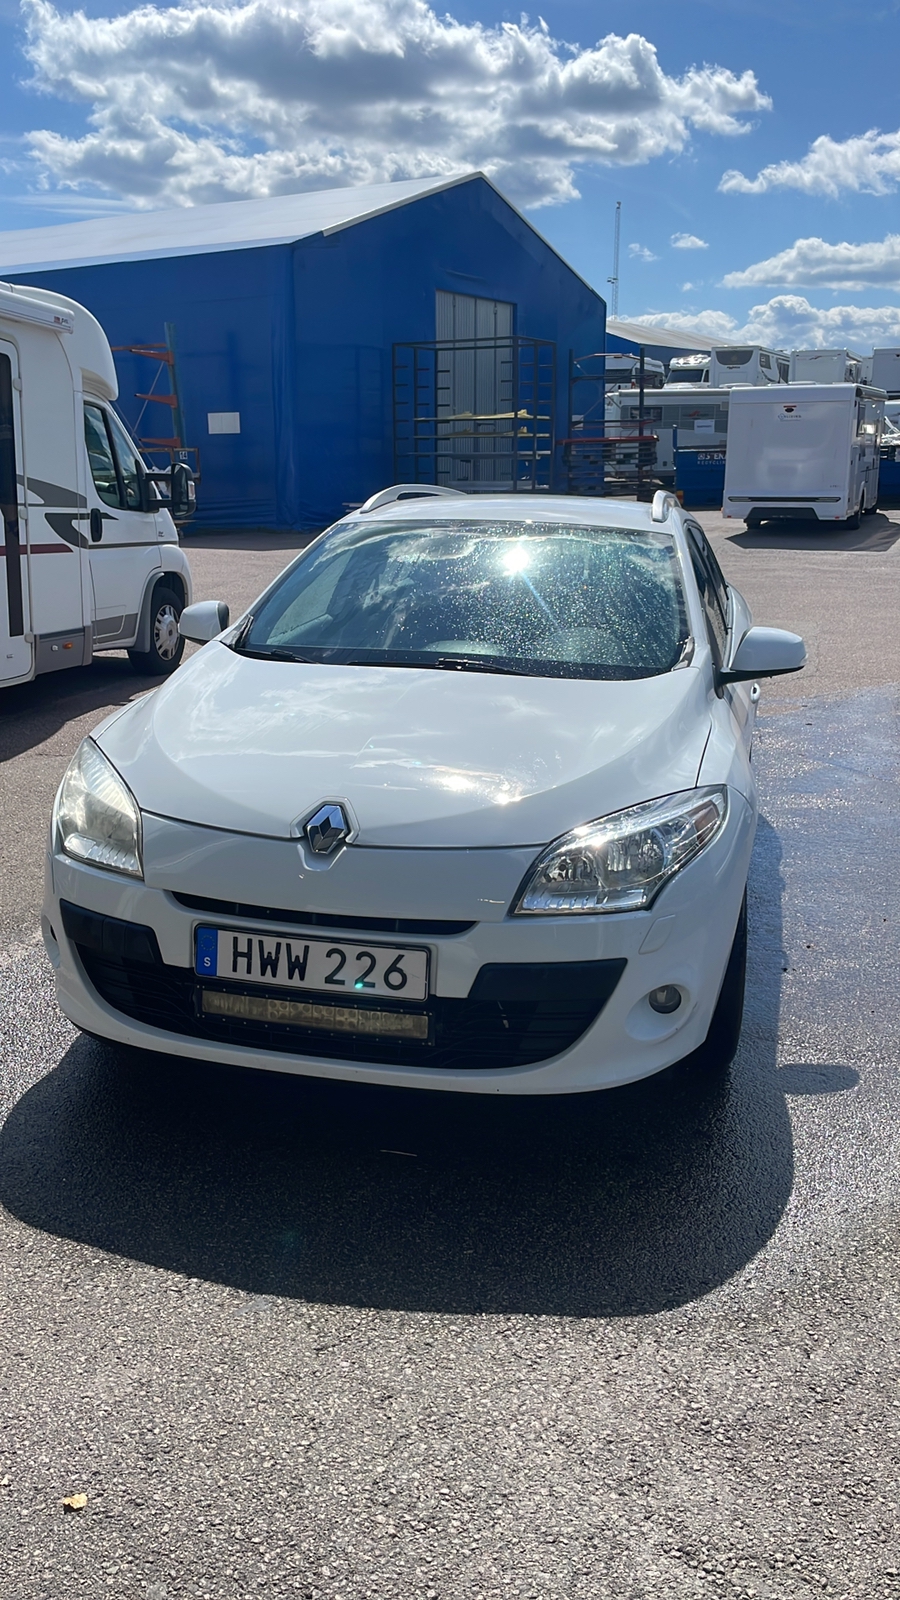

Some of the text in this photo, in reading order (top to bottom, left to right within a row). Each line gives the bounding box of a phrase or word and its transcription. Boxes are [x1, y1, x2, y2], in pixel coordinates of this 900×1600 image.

[180, 451, 187, 459] 14
[705, 452, 727, 460] SEN
[203, 956, 211, 967] S
[232, 936, 408, 991] HWW 226
